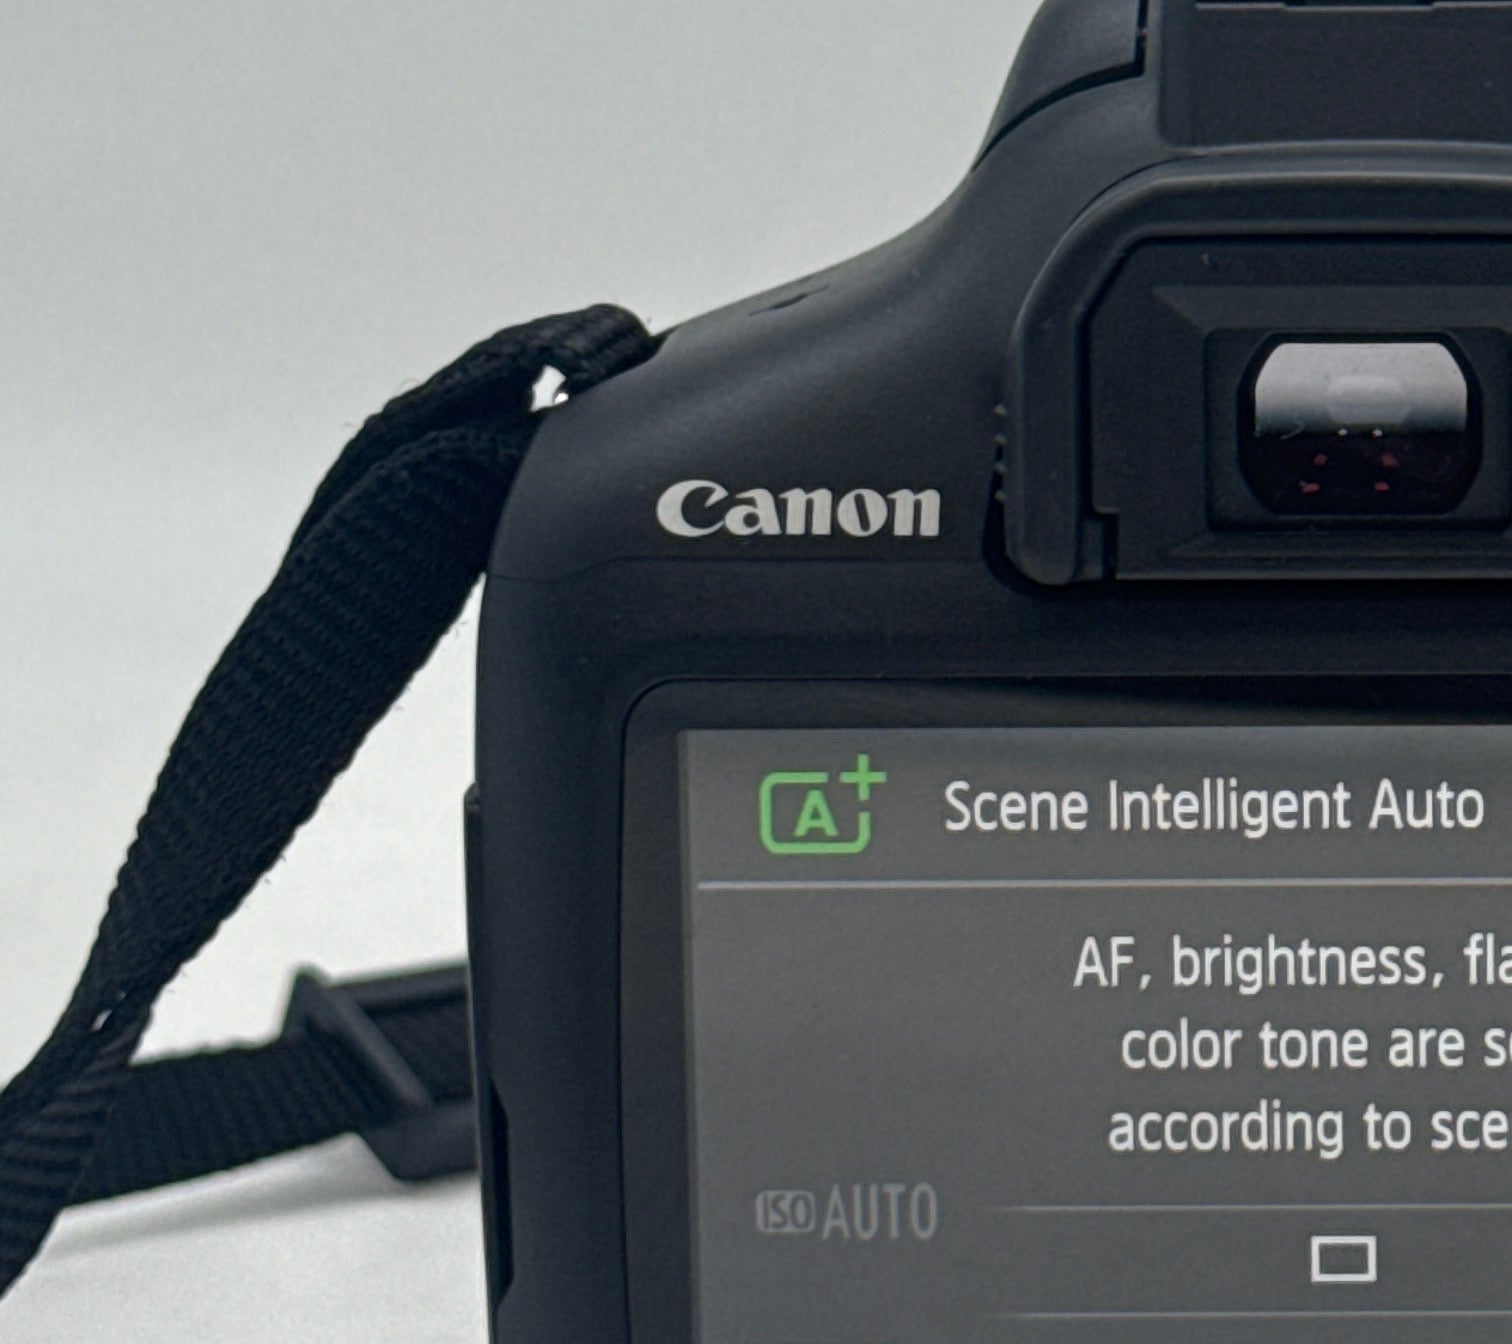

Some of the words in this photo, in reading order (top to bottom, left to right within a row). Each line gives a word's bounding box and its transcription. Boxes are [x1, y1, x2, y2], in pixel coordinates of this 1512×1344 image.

[656, 479, 941, 538] Canon
[944, 780, 1088, 831] Scene
[1109, 777, 1352, 839] Intelligent
[1368, 778, 1484, 829] Auto
[1073, 936, 1151, 990] AF,
[1173, 933, 1444, 995] brightness,
[1122, 1017, 1243, 1069] color
[1258, 1021, 1368, 1069] tone
[1388, 1028, 1465, 1068] are
[1108, 1098, 1343, 1160] according
[1362, 1103, 1412, 1150] to
[755, 1189, 816, 1234] ISO
[822, 1181, 939, 1241] AUTO
